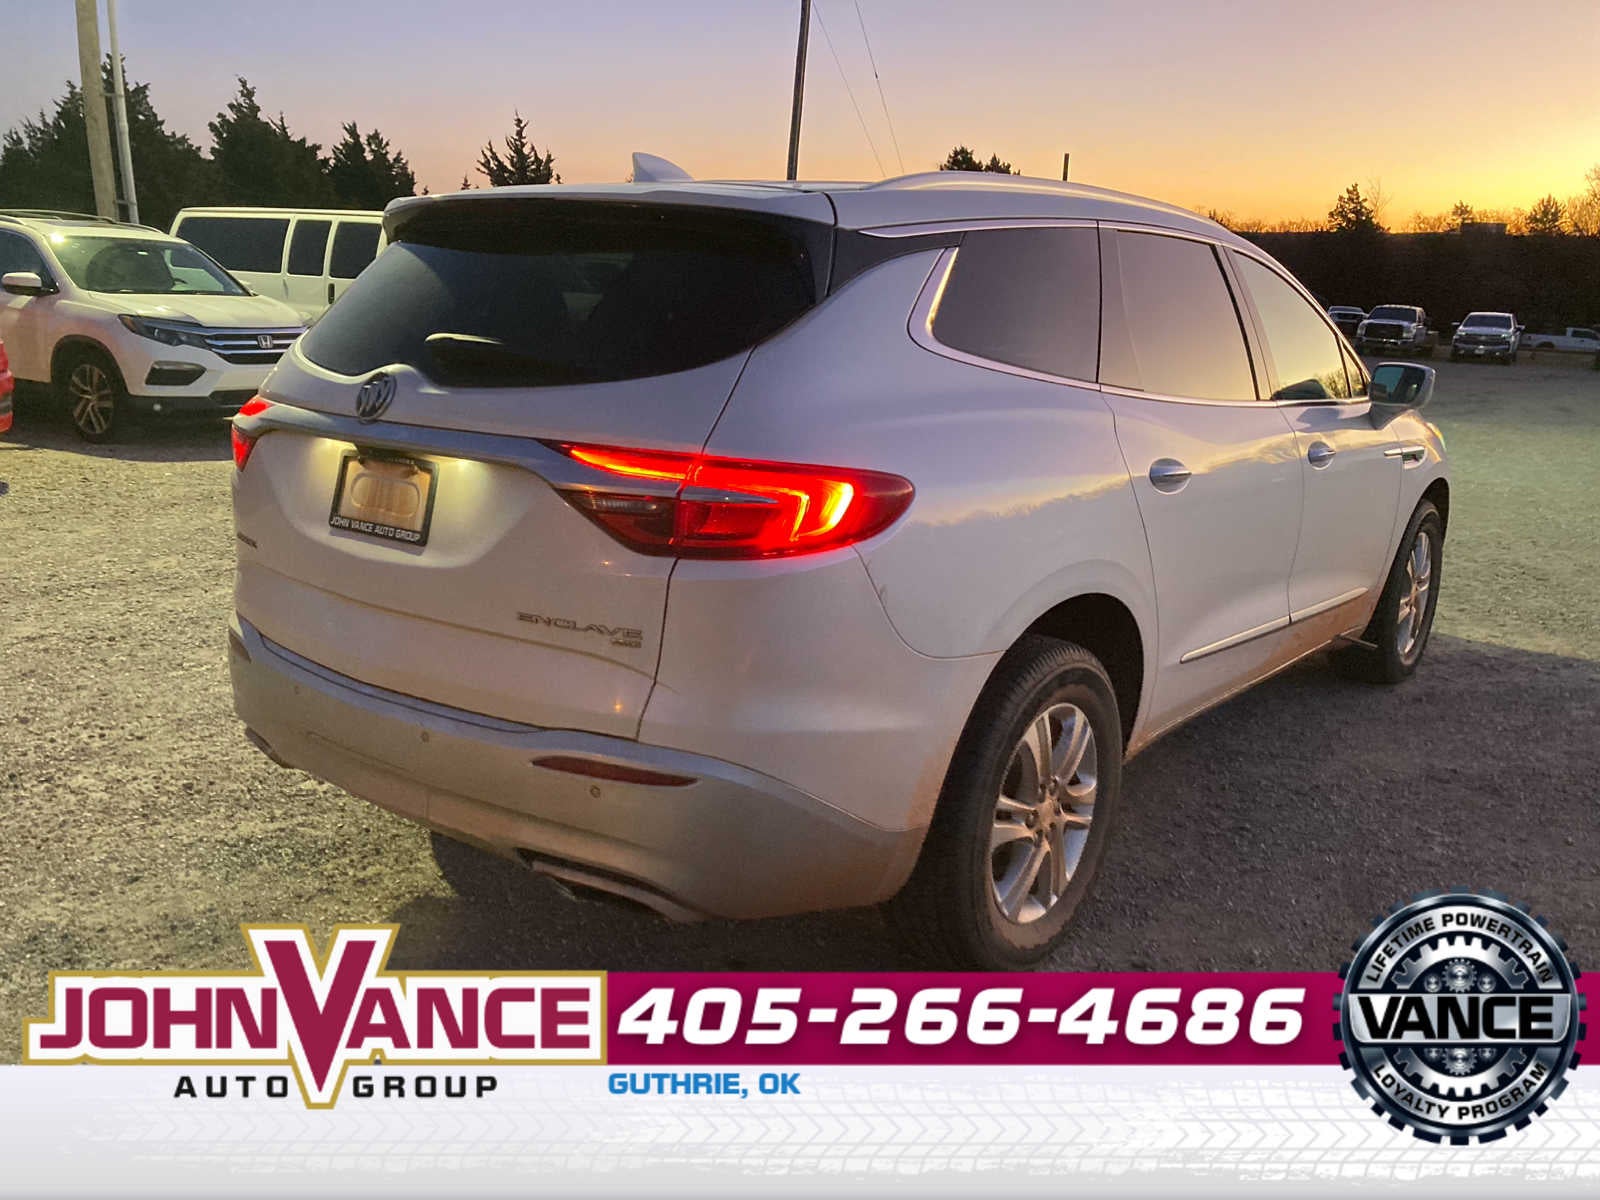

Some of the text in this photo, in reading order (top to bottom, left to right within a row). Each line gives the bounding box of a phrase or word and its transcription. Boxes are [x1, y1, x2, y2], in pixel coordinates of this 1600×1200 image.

[330, 516, 420, 542] JOHN VANCE AUTO GROUP
